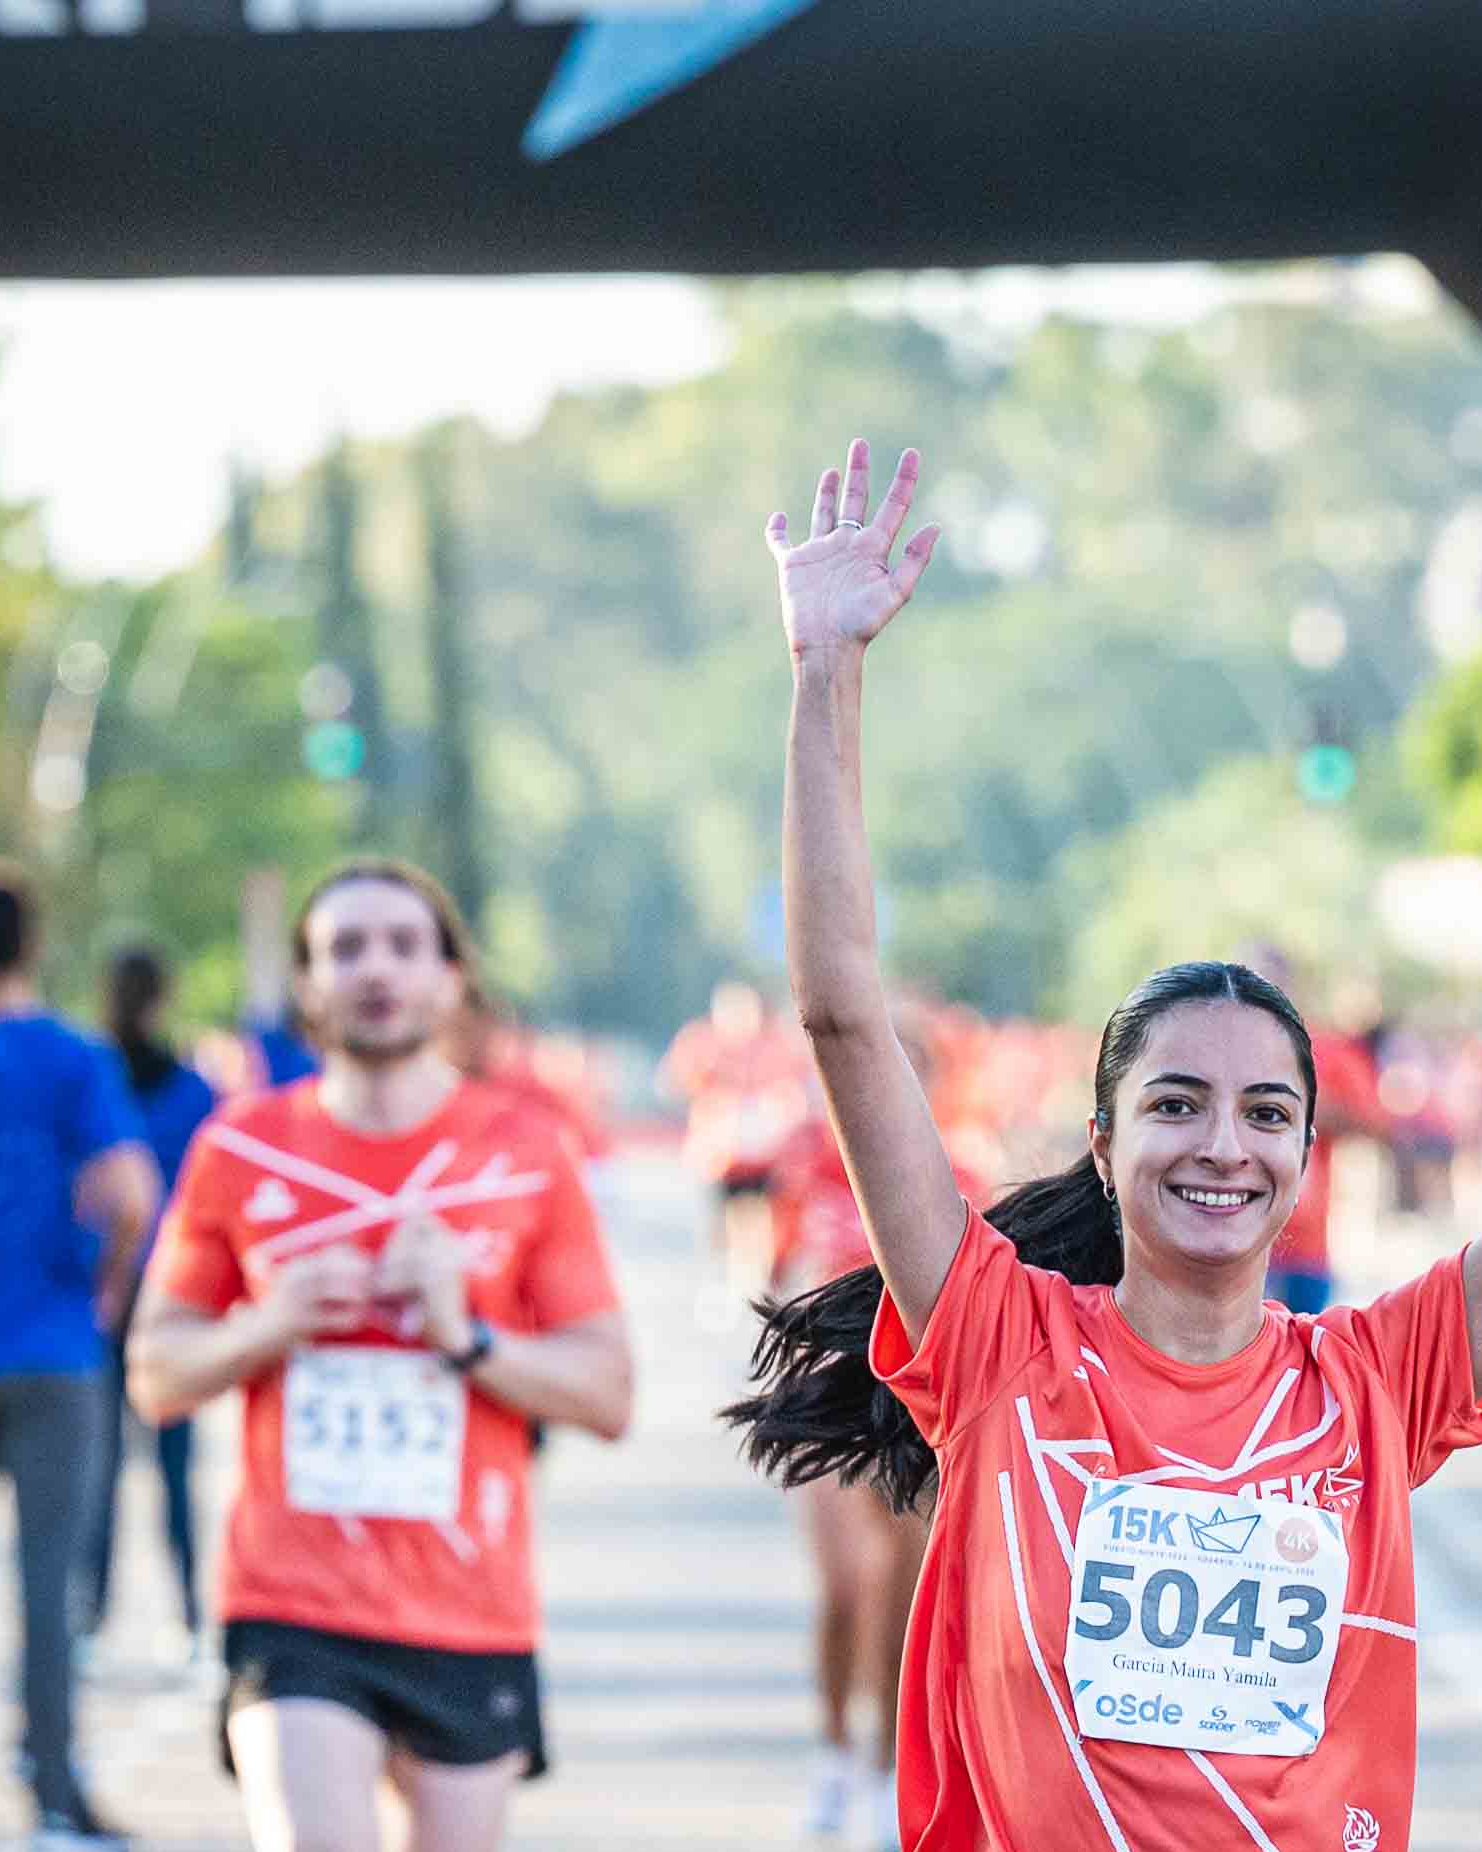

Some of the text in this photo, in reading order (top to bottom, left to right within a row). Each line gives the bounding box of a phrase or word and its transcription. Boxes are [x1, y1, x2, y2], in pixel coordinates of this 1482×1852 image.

[1107, 1504, 1181, 1547] 15K
[1284, 1531, 1313, 1549] 4K
[1074, 1559, 1328, 1665] 5043
[1222, 1665, 1279, 1689] Yamila
[1095, 1693, 1183, 1725] osde
